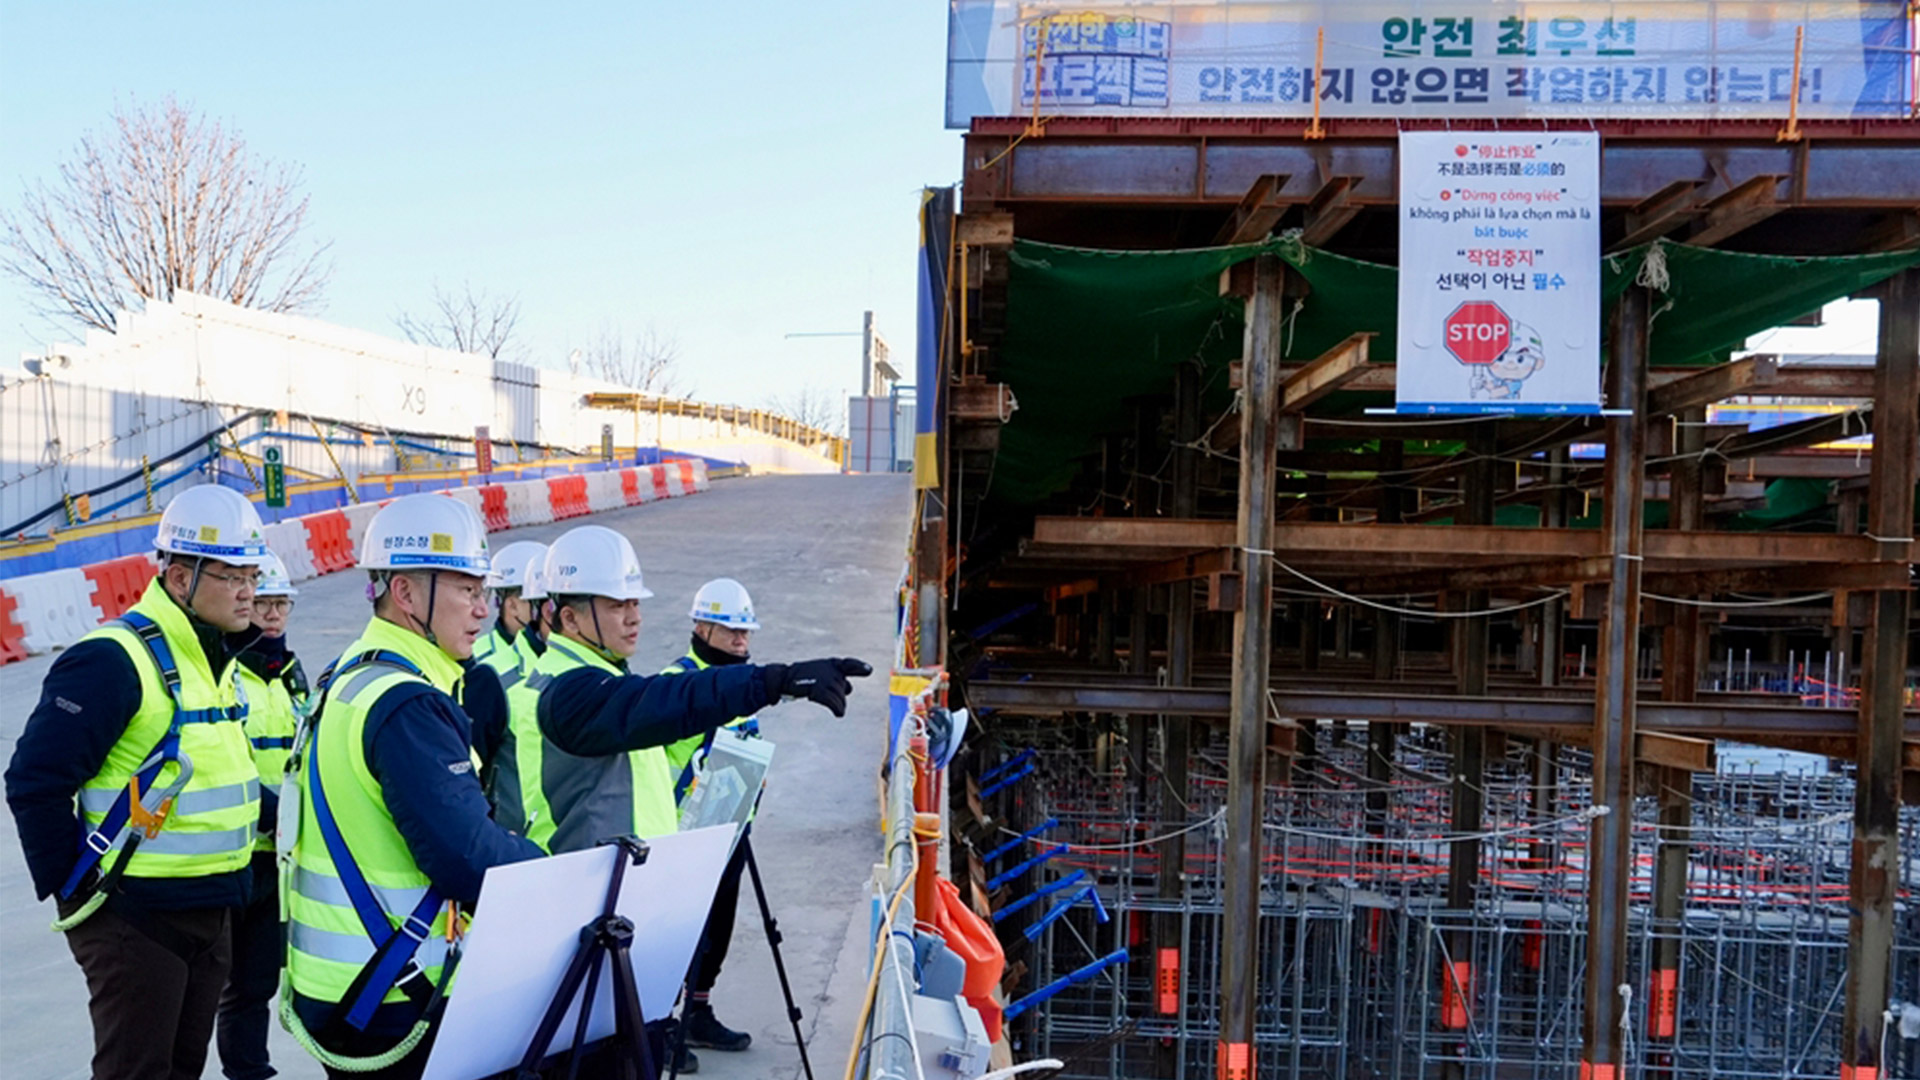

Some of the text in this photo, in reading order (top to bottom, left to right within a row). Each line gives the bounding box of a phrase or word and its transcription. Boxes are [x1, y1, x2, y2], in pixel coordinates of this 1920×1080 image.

[1382, 16, 1636, 57] 안전 최우선
[1023, 55, 1169, 107] 프로젝트
[1199, 66, 1822, 104] 안전하지 않으면 작업하지 않는다!
[1438, 162, 1566, 176] 不是选择而是必须的
[1500, 188, 1532, 204] công
[1409, 207, 1449, 223] không
[1485, 207, 1496, 219] là
[1499, 207, 1519, 220] lựa
[1522, 207, 1552, 221] chọn
[1556, 207, 1576, 219] mà
[1580, 207, 1591, 219] là
[1436, 273, 1566, 290] 선택이 아닌 필수
[1449, 323, 1508, 341] STOP
[402, 383, 426, 415] X9
[559, 565, 577, 576] VIP
